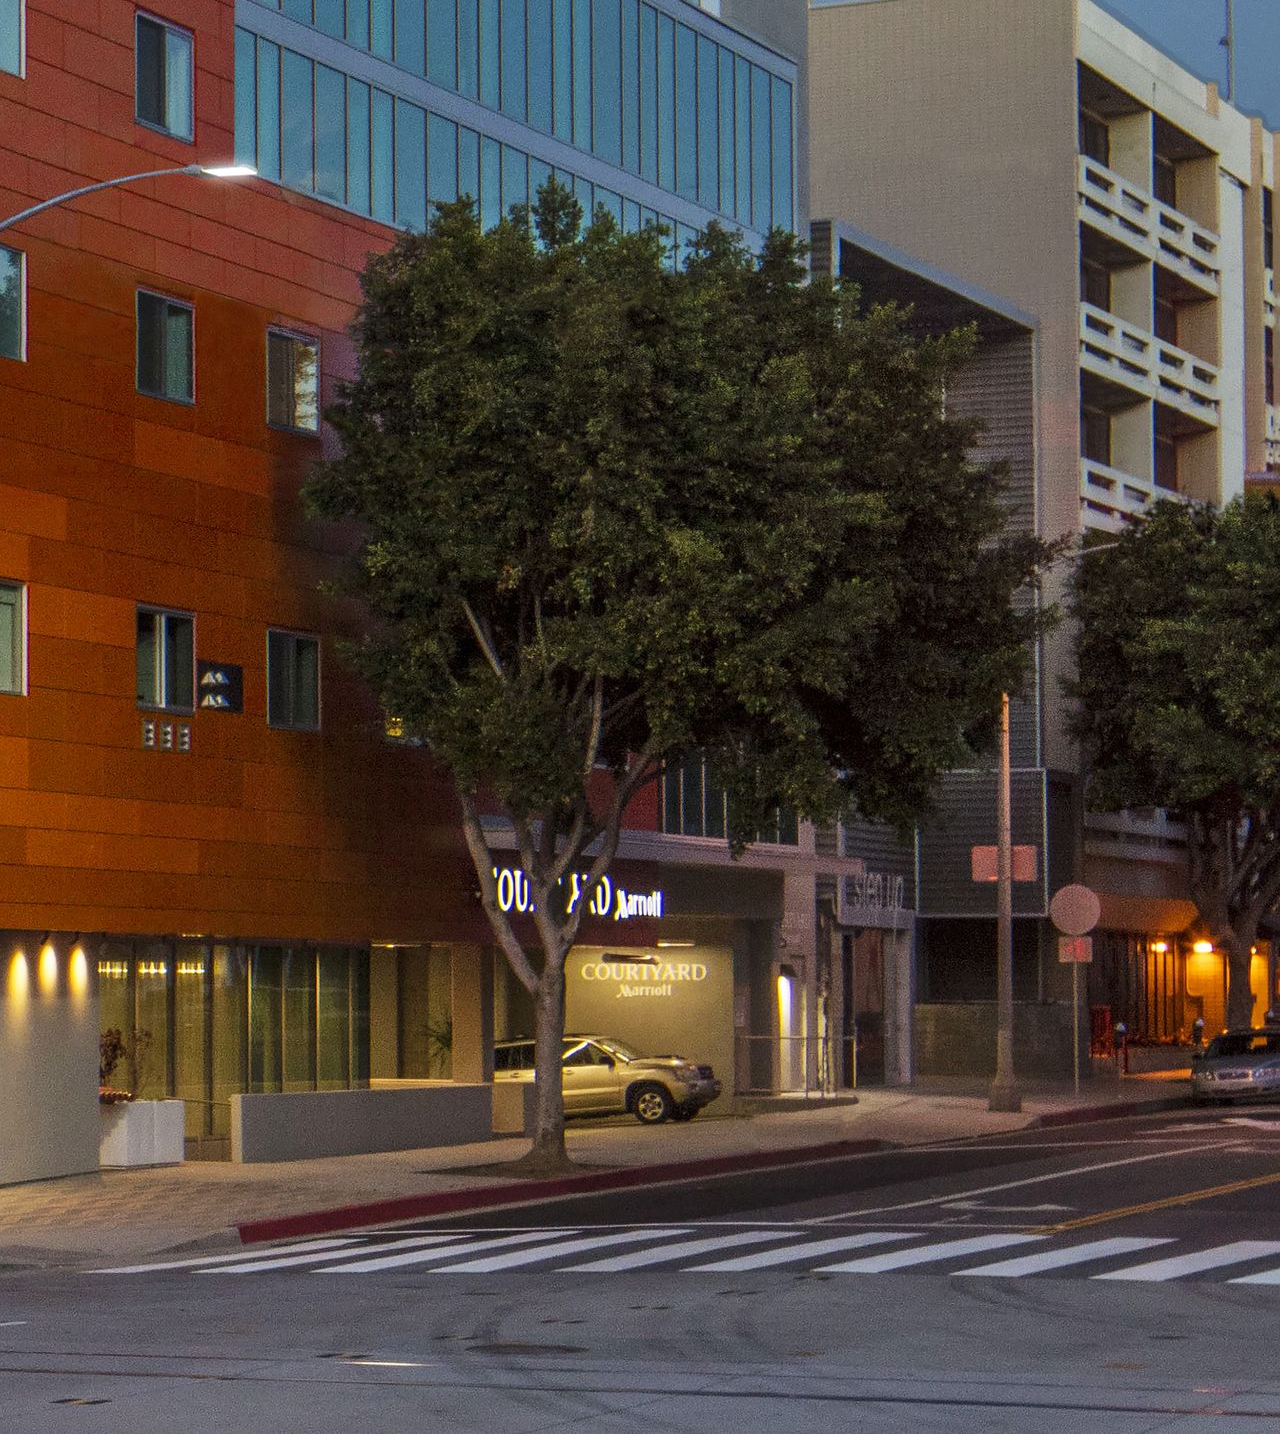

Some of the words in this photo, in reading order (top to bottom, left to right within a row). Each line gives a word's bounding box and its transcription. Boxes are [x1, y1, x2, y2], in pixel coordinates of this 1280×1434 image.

[614, 889, 663, 921] Marriott
[581, 964, 707, 981] COURTYARD
[616, 984, 672, 998] Marriott
